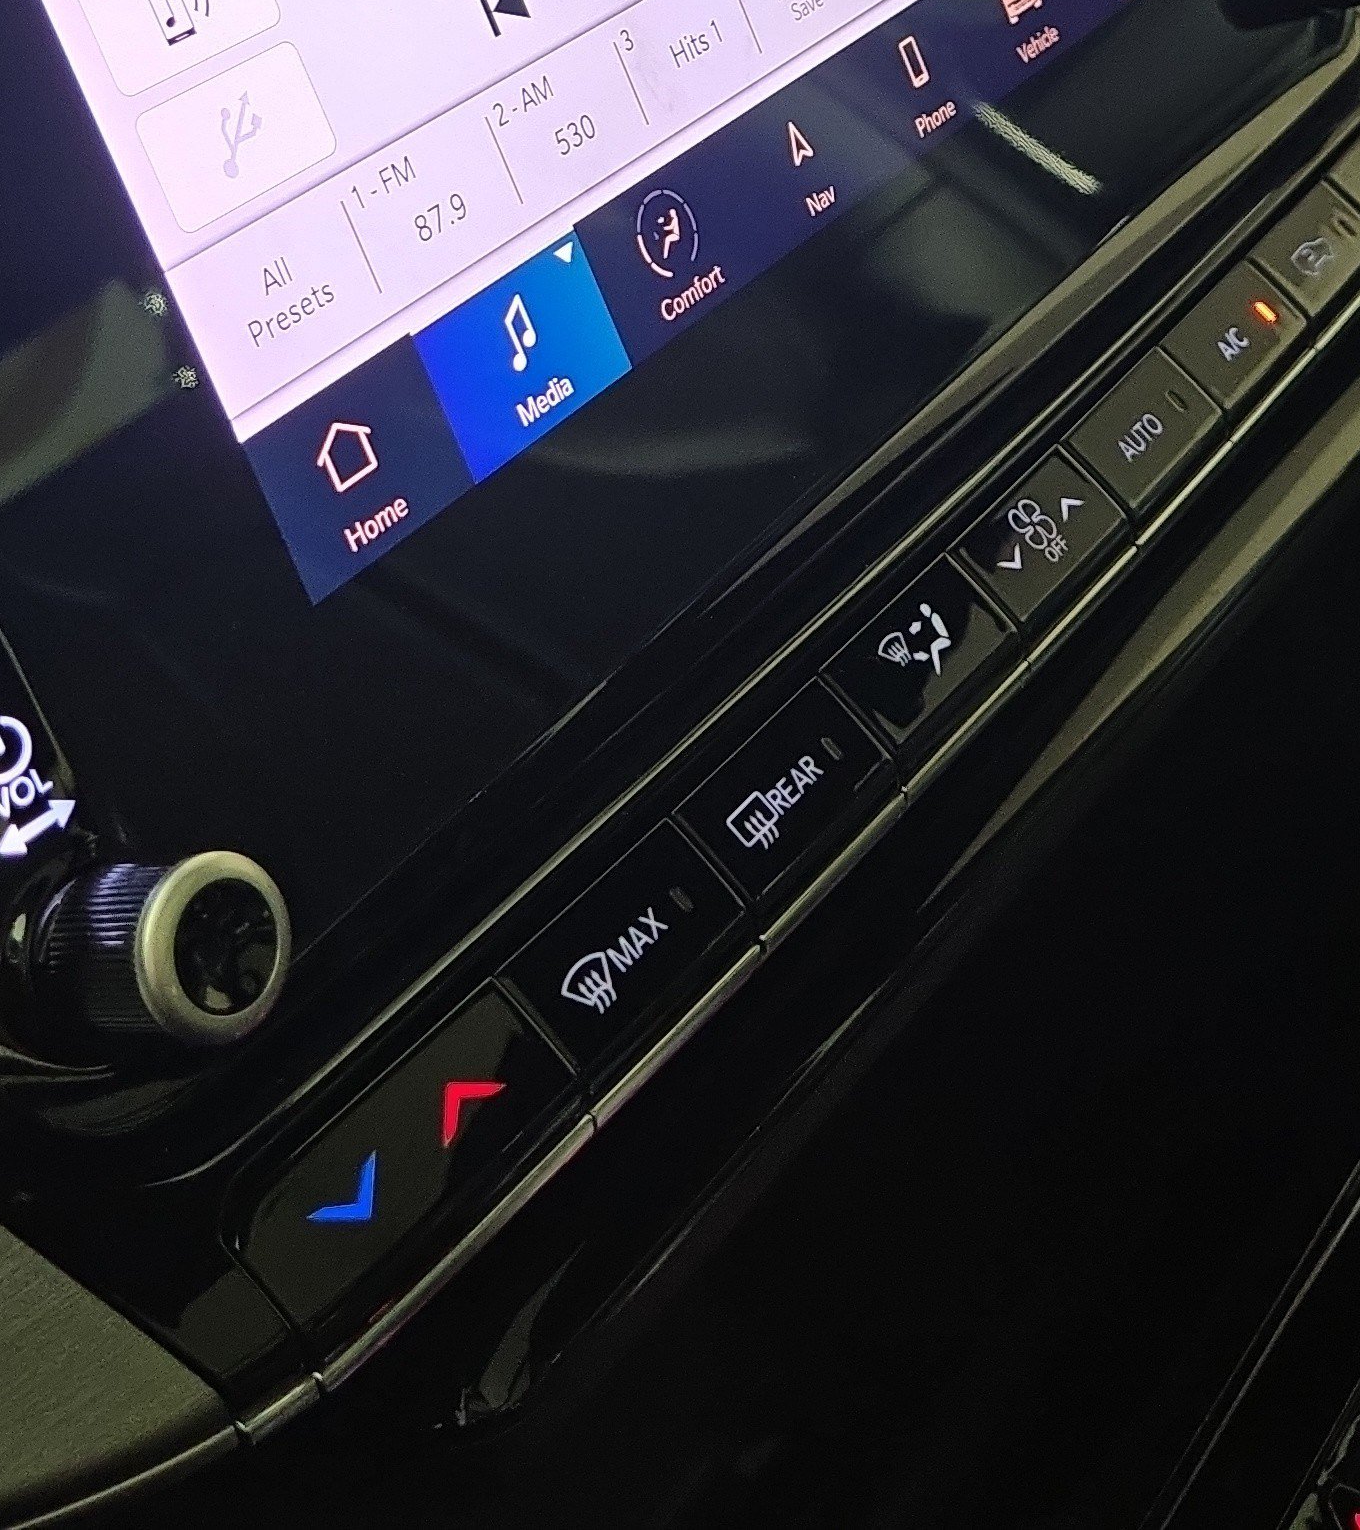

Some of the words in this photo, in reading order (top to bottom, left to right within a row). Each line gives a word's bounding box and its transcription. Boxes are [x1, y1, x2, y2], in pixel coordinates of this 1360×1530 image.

[619, 27, 635, 52] 3
[668, 29, 713, 69] Hits
[708, 18, 724, 46] 1
[1014, 23, 1061, 66] Vehicle
[520, 74, 555, 113] AM
[553, 113, 597, 156] 530
[912, 98, 958, 139] Phone
[378, 155, 417, 195] FM
[413, 193, 467, 242] 87.9
[805, 184, 837, 218] Nav
[261, 256, 293, 297] All
[659, 263, 728, 323] Comfort
[246, 278, 337, 348] Presets
[1216, 325, 1252, 363] A/C
[515, 374, 576, 428] Media
[1116, 411, 1165, 465] AUTO
[342, 493, 410, 554] Home
[1043, 533, 1071, 564] OFF
[768, 754, 825, 816] REAR
[605, 904, 670, 976] MAX
